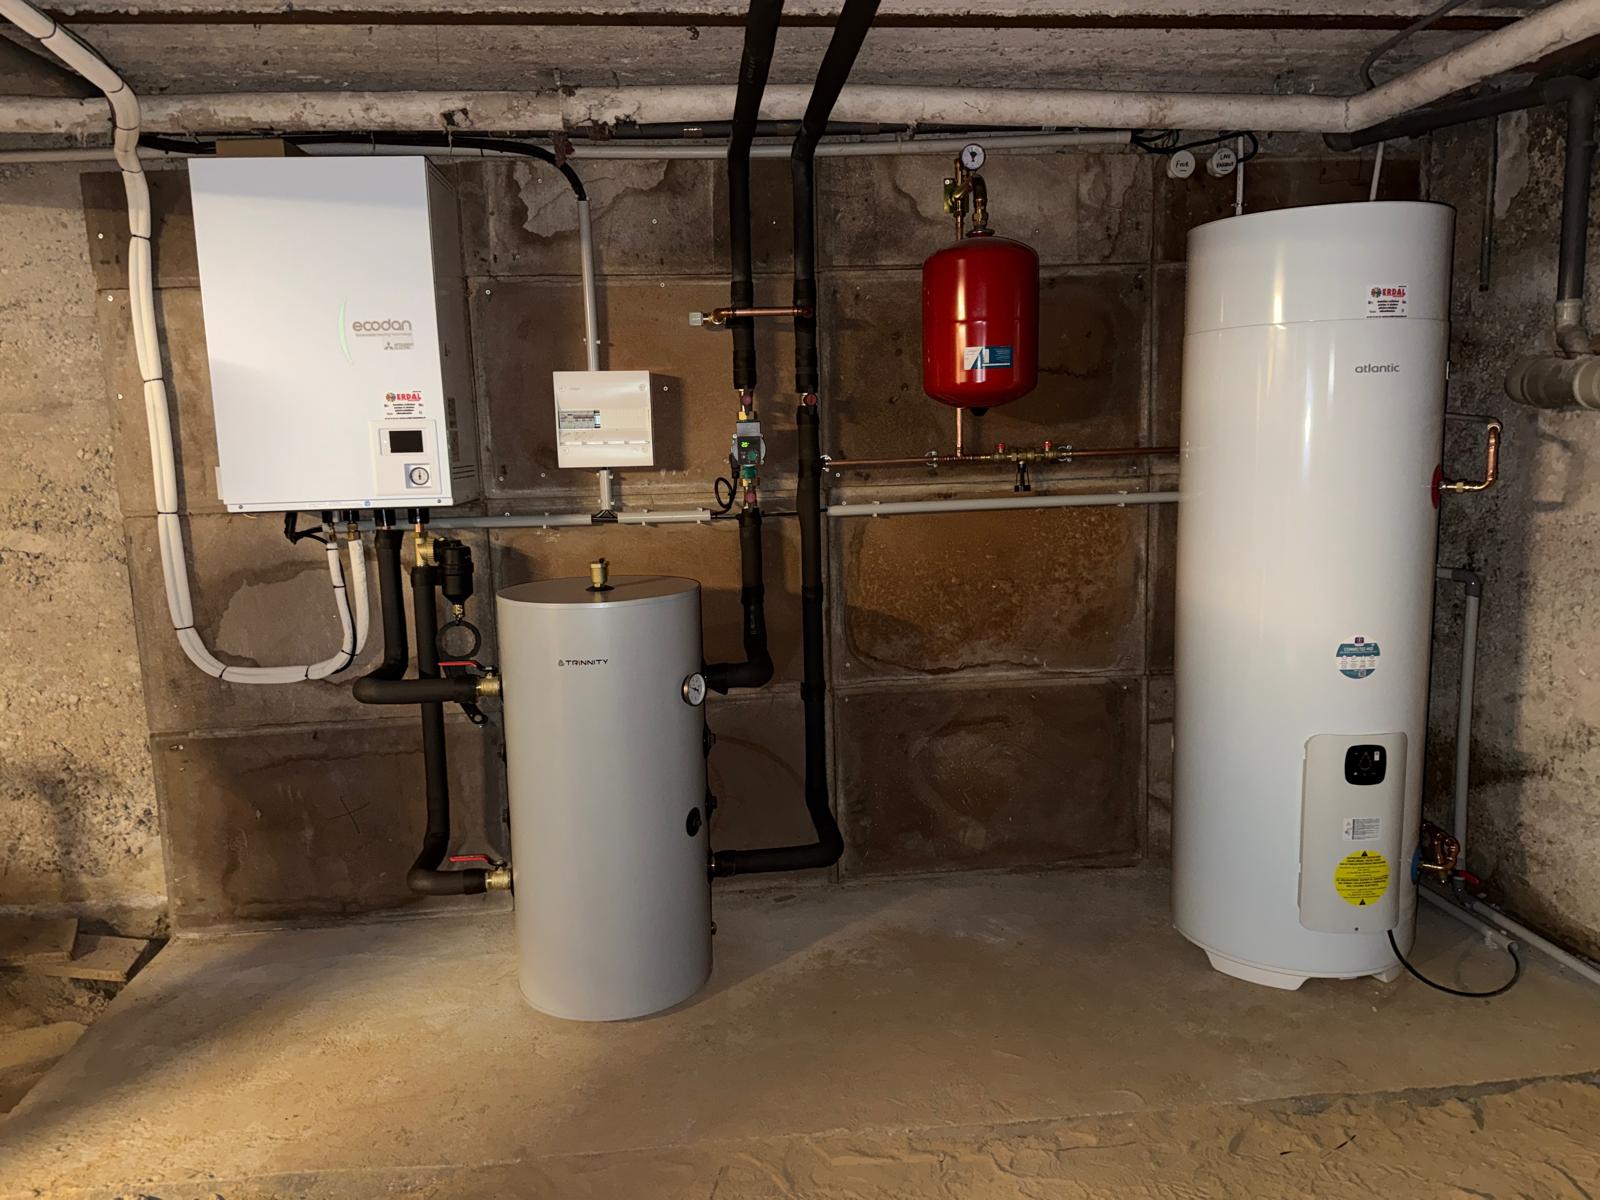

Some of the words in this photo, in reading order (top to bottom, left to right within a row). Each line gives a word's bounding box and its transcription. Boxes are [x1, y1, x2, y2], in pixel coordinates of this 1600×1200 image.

[1382, 288, 1406, 297] ERDAL
[352, 318, 412, 332] ecodan
[1354, 363, 1400, 374] atlantic
[396, 393, 422, 401] ERDAL
